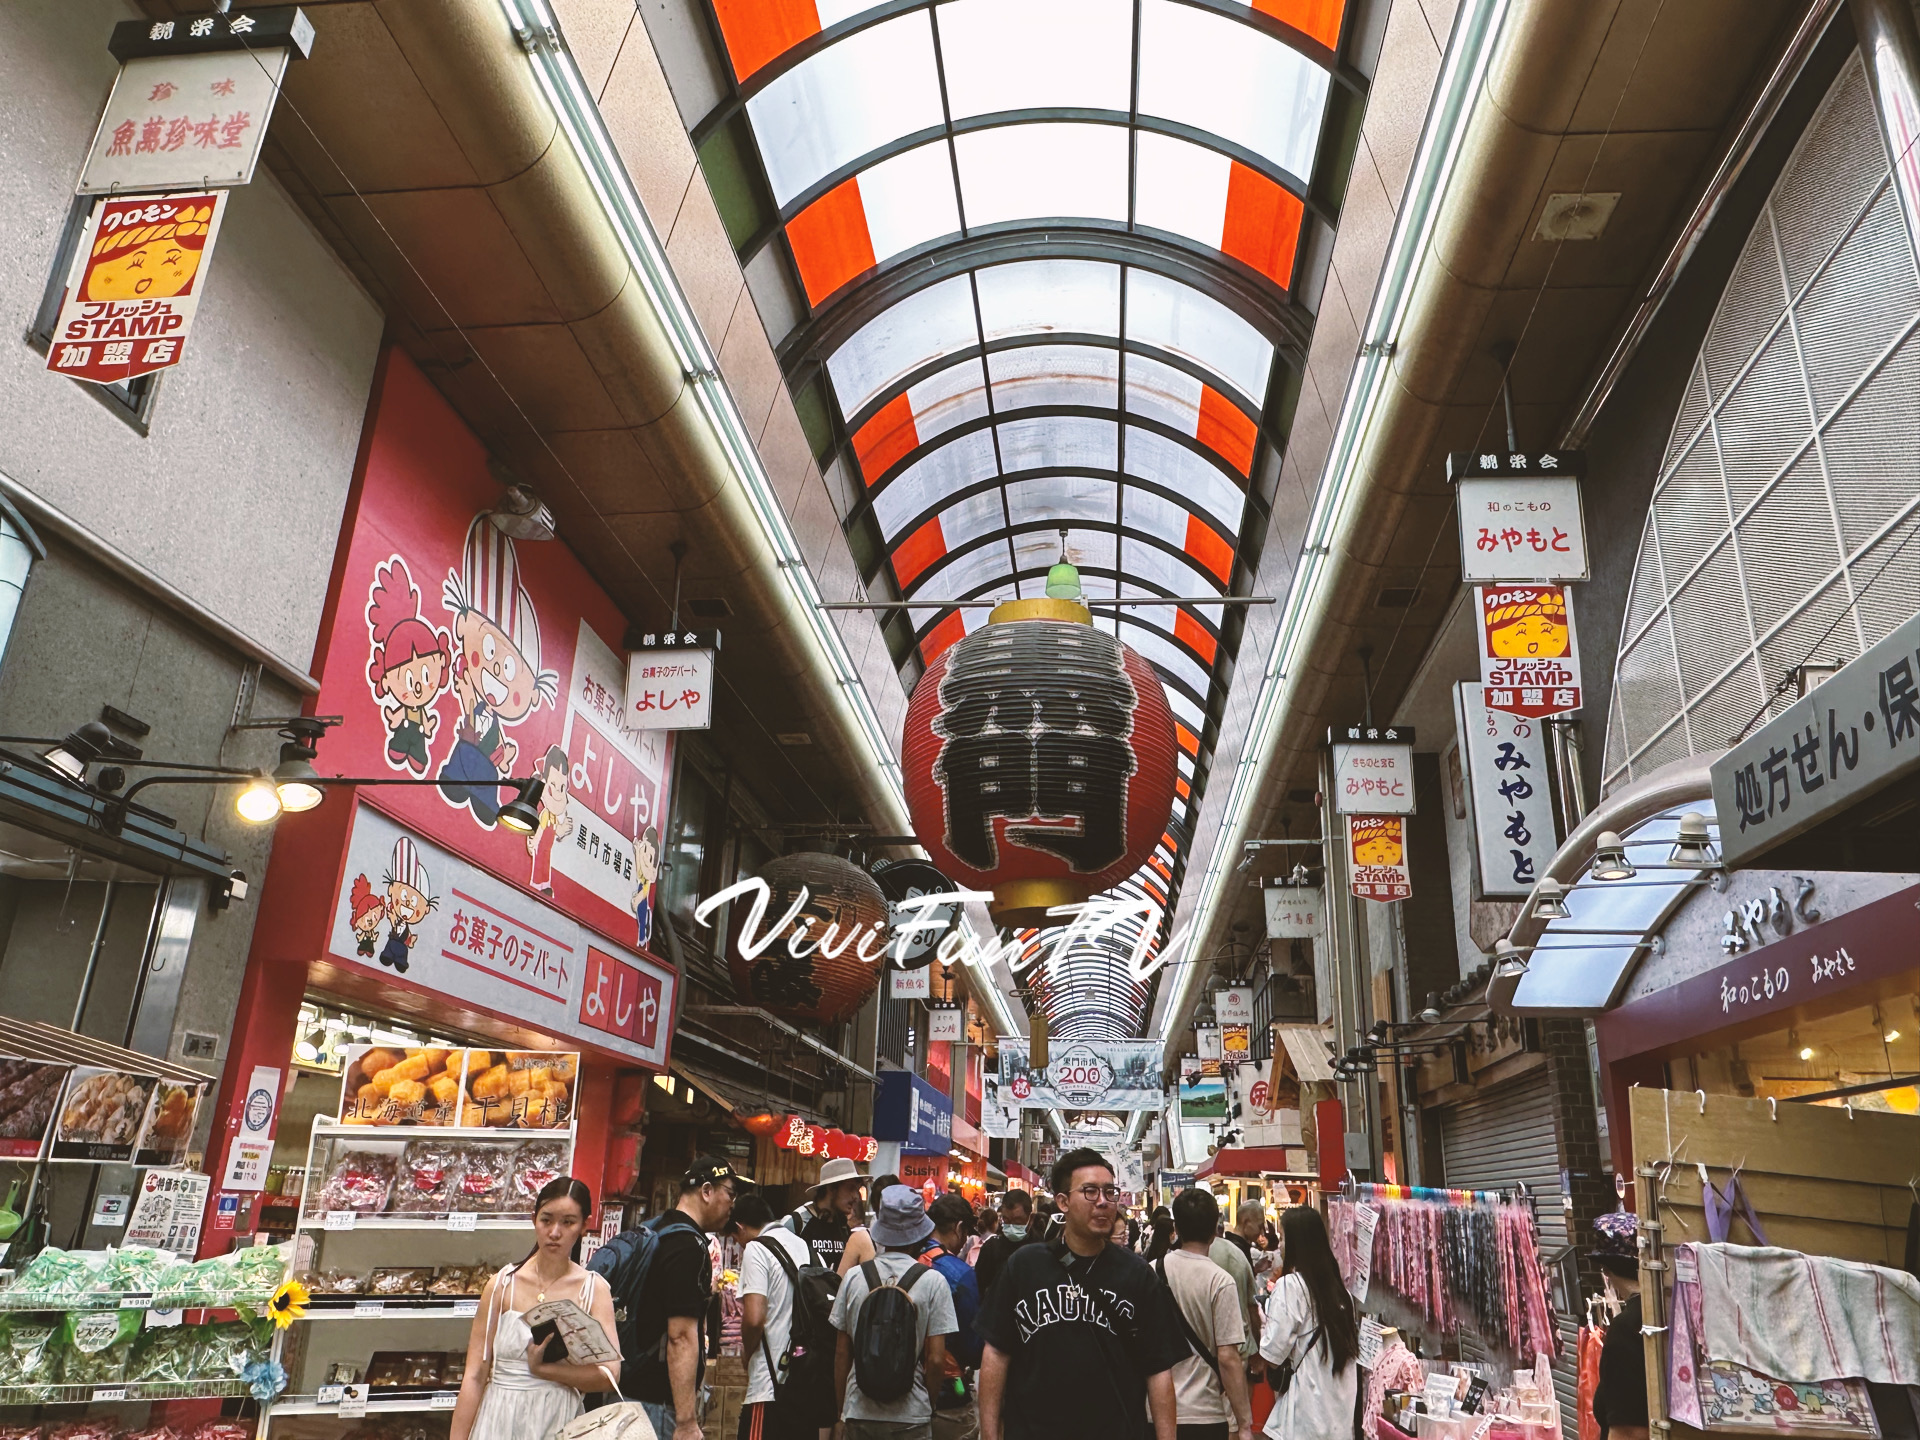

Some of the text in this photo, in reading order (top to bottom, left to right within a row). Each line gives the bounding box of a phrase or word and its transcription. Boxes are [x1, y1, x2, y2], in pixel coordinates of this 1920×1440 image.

[103, 204, 179, 232] クロモン
[82, 299, 173, 320] フレッシュ
[65, 314, 183, 340] STAMP
[57, 339, 177, 368] 加盟店
[1487, 501, 1552, 512] 和のこもの
[1476, 526, 1571, 553] みやもと
[1485, 589, 1538, 609] クロモン
[1495, 658, 1563, 671] フレッシュ
[1489, 670, 1573, 686] STAMP
[635, 688, 701, 712] よしや
[1490, 688, 1575, 707] 加盟店
[1734, 648, 1920, 834] 処方せん・保
[571, 733, 650, 837] よしや
[1346, 777, 1405, 797] みやもと
[1494, 742, 1535, 884] みやもと
[1352, 818, 1385, 831] クロモン
[1355, 872, 1405, 884] STAMP
[1358, 865, 1399, 874] フレッシュ
[1356, 884, 1407, 896] 加盟店
[450, 908, 568, 990] お菓子のデパート
[1720, 947, 1856, 1013] 和のこもの みやもと
[586, 961, 657, 1037] よしや
[1058, 1067, 1101, 1084] 200
[1013, 1080, 1029, 1096] 祝
[348, 1097, 454, 1124] 北海道産
[711, 1166, 729, 1177] 1ST
[904, 1165, 940, 1177] Sushi
